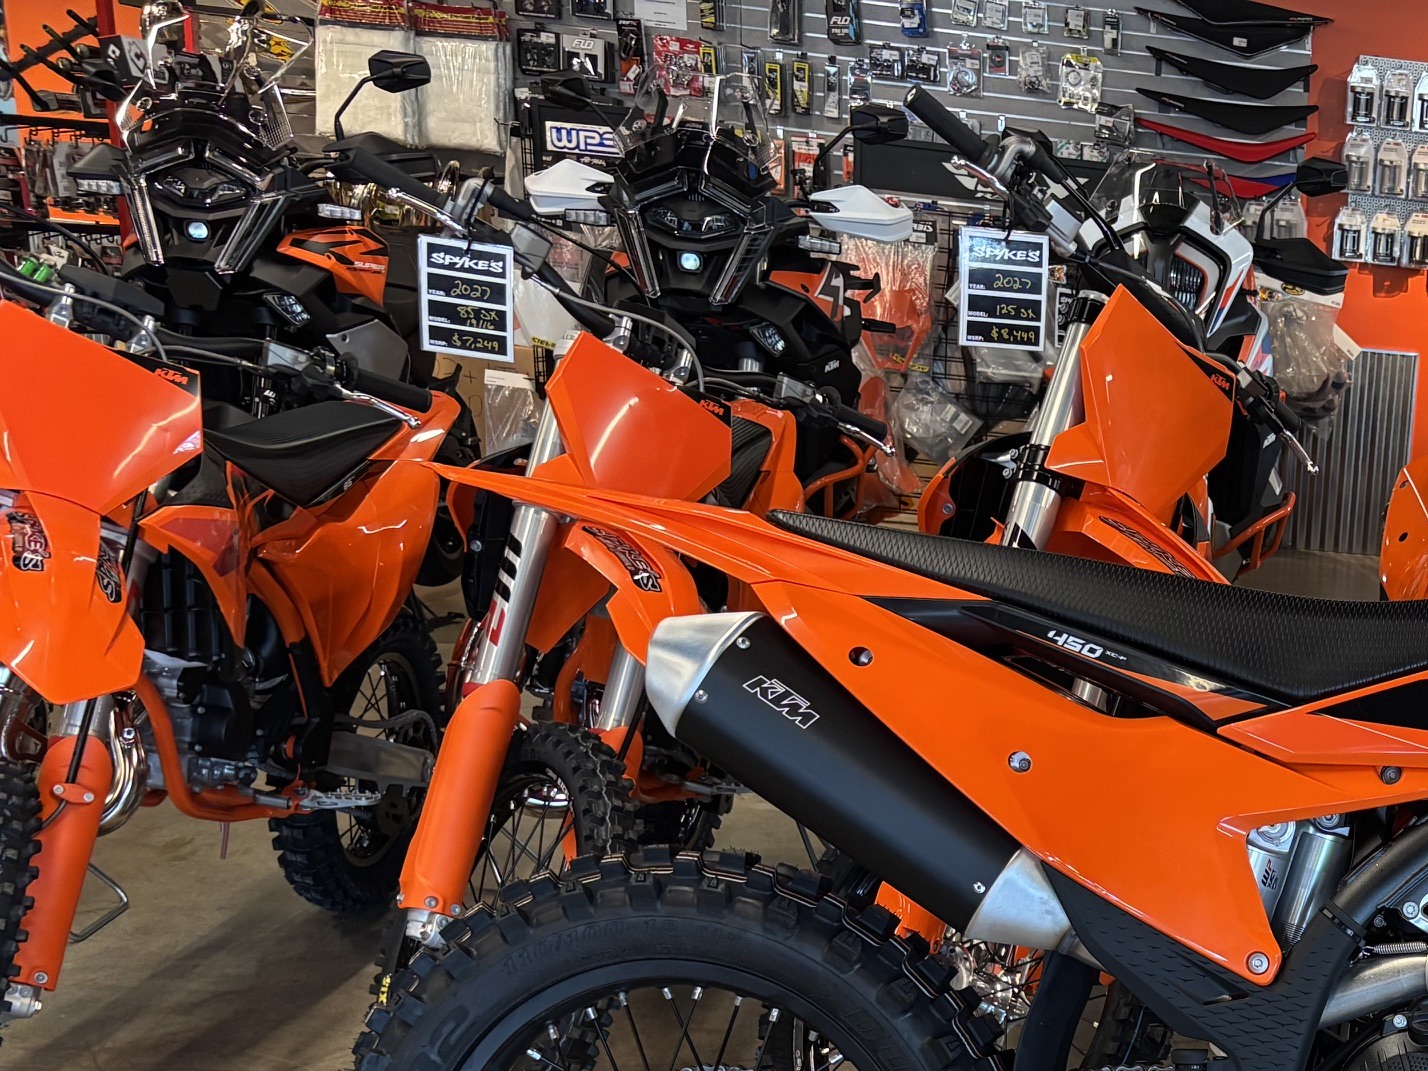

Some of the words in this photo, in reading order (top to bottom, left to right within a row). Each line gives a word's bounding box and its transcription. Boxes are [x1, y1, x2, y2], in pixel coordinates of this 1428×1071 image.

[829, 16, 851, 25] FLO
[572, 38, 594, 49] FLO
[972, 243, 1040, 262] SPYKE'S
[430, 252, 504, 273] SPYKE'S
[428, 289, 446, 297] YEAR:
[451, 280, 491, 300] 2027
[993, 273, 1031, 290] 2027
[428, 315, 451, 324] MODEL:
[457, 306, 480, 319] 85
[996, 304, 1017, 316] 125
[451, 332, 499, 352] $7,249
[991, 325, 1035, 343] $8,449
[825, 359, 840, 373] KTM
[154, 367, 189, 385] KTM
[1210, 373, 1230, 391] KTM
[700, 400, 725, 416] KTM
[1047, 630, 1104, 658] 450
[742, 675, 820, 729] KTM
[1261, 859, 1273, 888] WP
